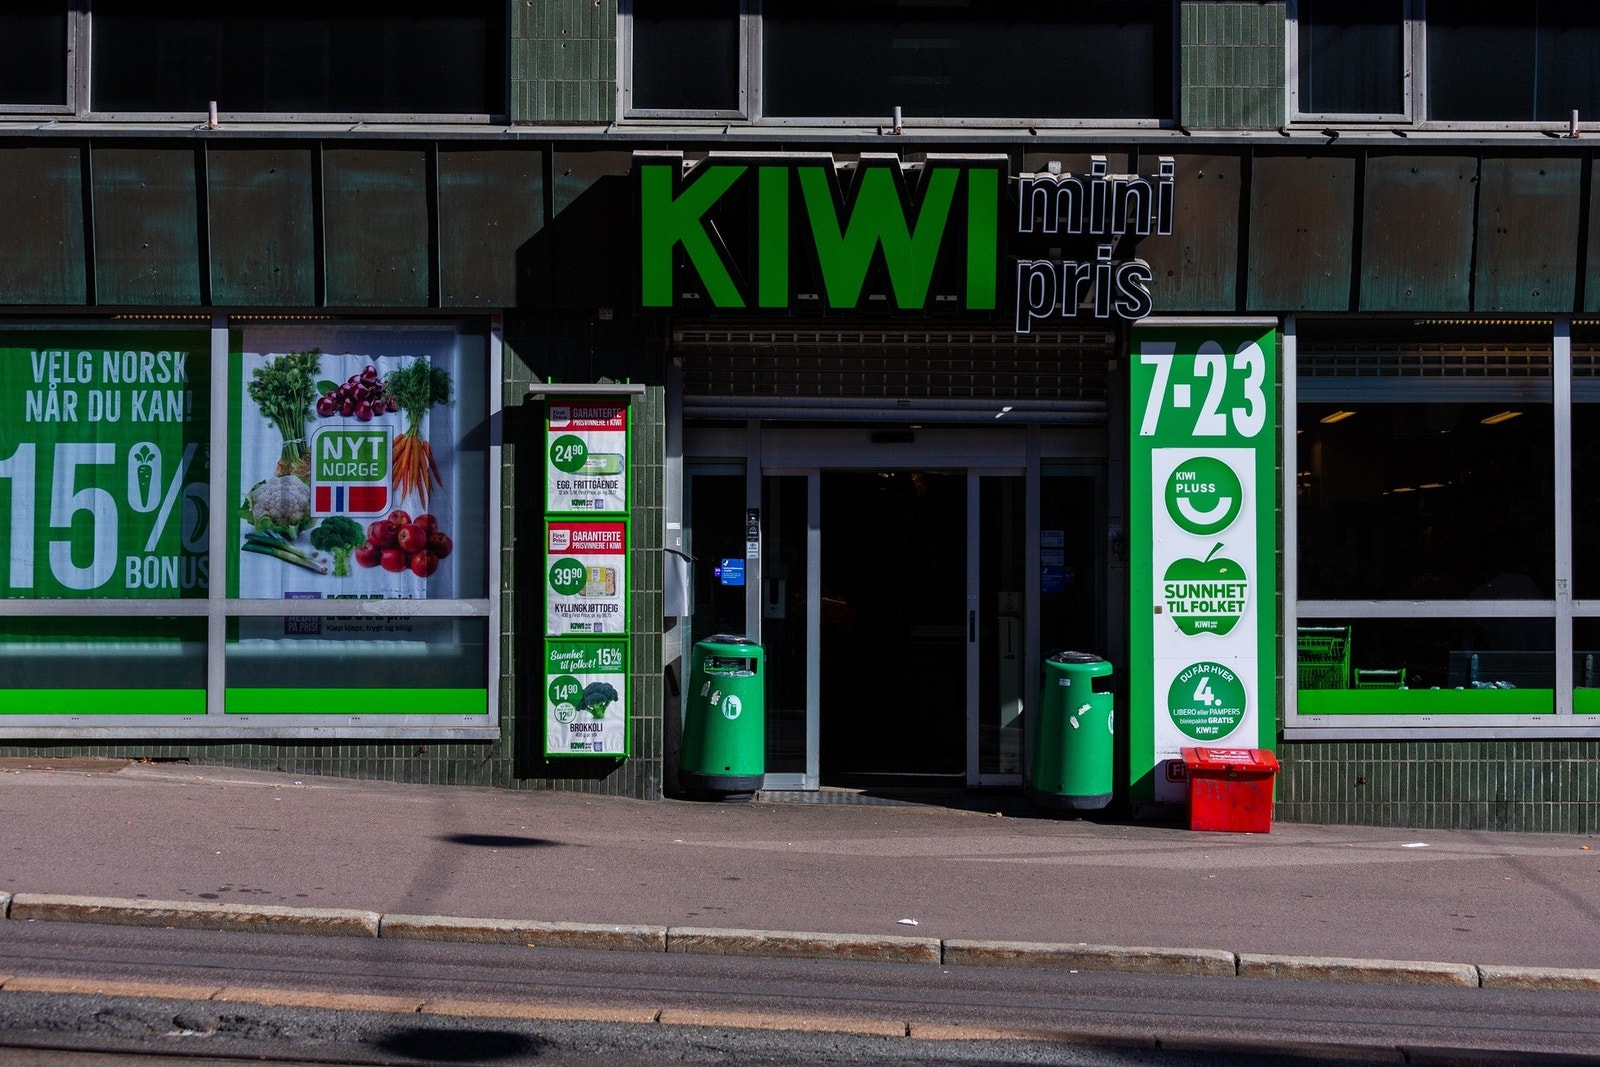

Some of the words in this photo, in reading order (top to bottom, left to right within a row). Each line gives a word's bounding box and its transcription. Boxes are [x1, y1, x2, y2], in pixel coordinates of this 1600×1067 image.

[1018, 156, 1175, 235] mini
[641, 165, 998, 309] KIWI
[1015, 244, 1153, 334] pris
[31, 351, 92, 383] VELG
[103, 351, 189, 383] NORSK
[1140, 340, 1266, 438] 7-23
[26, 383, 78, 422] NÅR
[88, 390, 121, 422] DU
[131, 390, 192, 422] KAN!
[572, 408, 622, 418] GARANTERTE
[323, 436, 384, 460] NYT
[323, 462, 379, 477] NORGE
[1176, 472, 1196, 480] KIWI
[557, 480, 572, 491] EGG,
[574, 478, 618, 490] FRITTGÅENDE
[1176, 484, 1216, 492] PLUSS
[572, 532, 621, 542] GARANTERTE
[126, 556, 209, 589] BONUS
[1164, 584, 1247, 598] SUNNHET
[554, 604, 618, 612] KYLLINGKJØTTDEIG
[1167, 601, 1188, 612] TIL
[1190, 601, 1245, 612] FOLKET
[550, 650, 584, 660] Sunnhet
[597, 648, 622, 665] 15%
[560, 660, 569, 670] til
[1180, 670, 1192, 682] DU
[1192, 664, 1210, 675] FÅR
[1211, 666, 1234, 682] HVER
[1194, 676, 1222, 706] 4.
[570, 723, 603, 732] BROKKOLI
[1173, 764, 1185, 776] Fi
